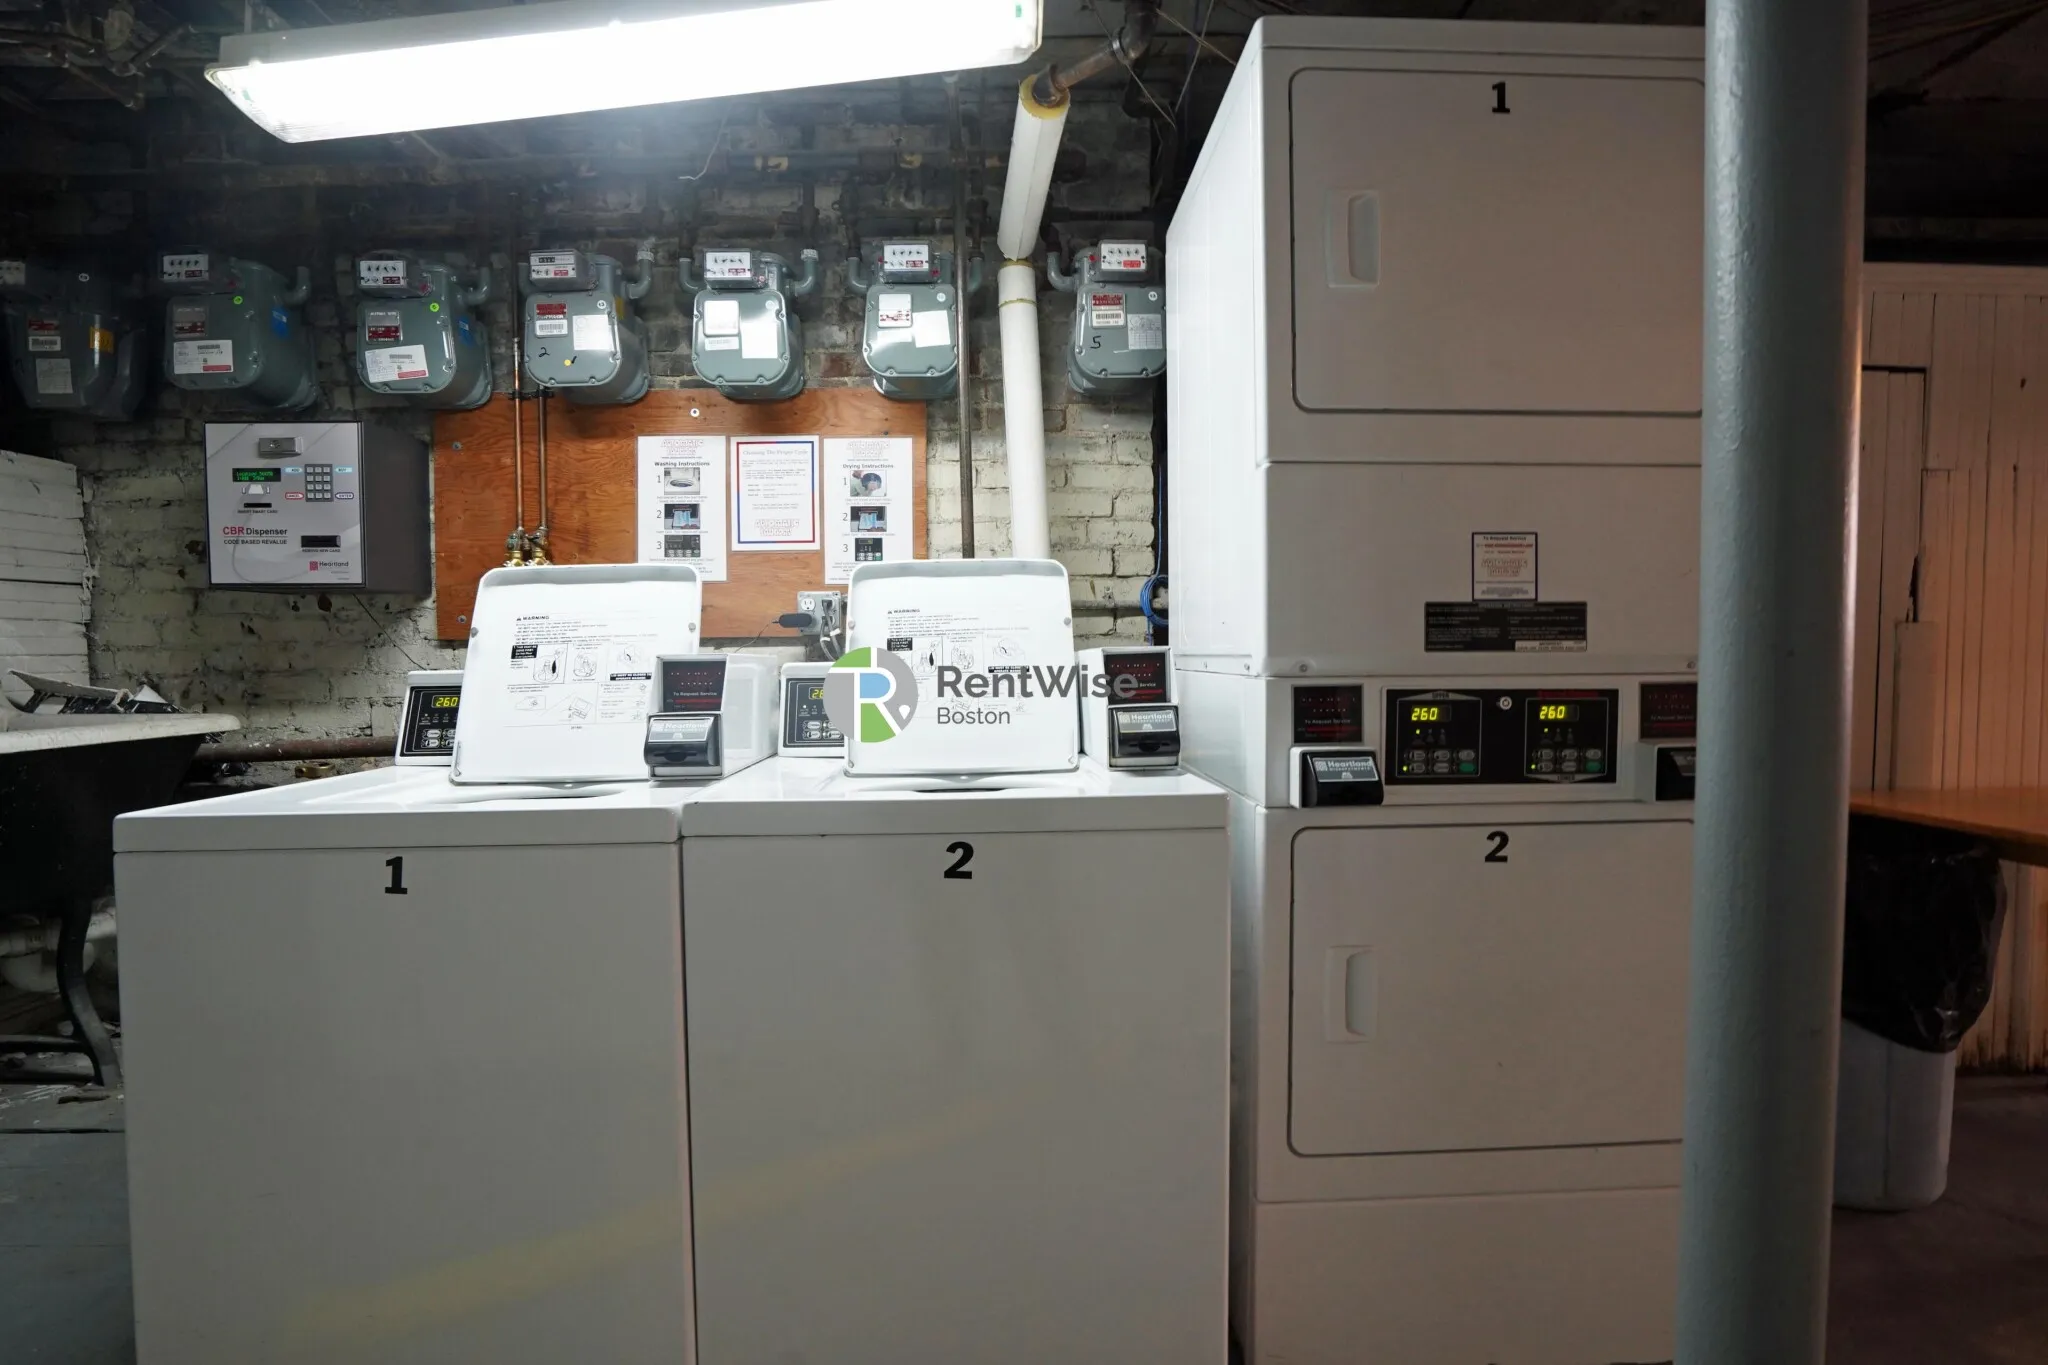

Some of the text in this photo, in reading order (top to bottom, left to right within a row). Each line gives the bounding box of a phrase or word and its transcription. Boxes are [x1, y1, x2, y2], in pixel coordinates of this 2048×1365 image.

[1492, 82, 1510, 113] 1
[657, 475, 661, 483] 1
[843, 477, 847, 486] 1
[656, 510, 662, 518] 2
[842, 513, 848, 521] 2
[223, 526, 288, 537] CBR Dispenser
[656, 541, 662, 550] 3
[842, 544, 848, 552] 3
[436, 697, 459, 707] 260
[1411, 707, 1438, 721] 260
[1539, 705, 1565, 719] 260
[1485, 831, 1509, 863] 2
[944, 841, 974, 879] 2
[385, 856, 407, 894] 1
